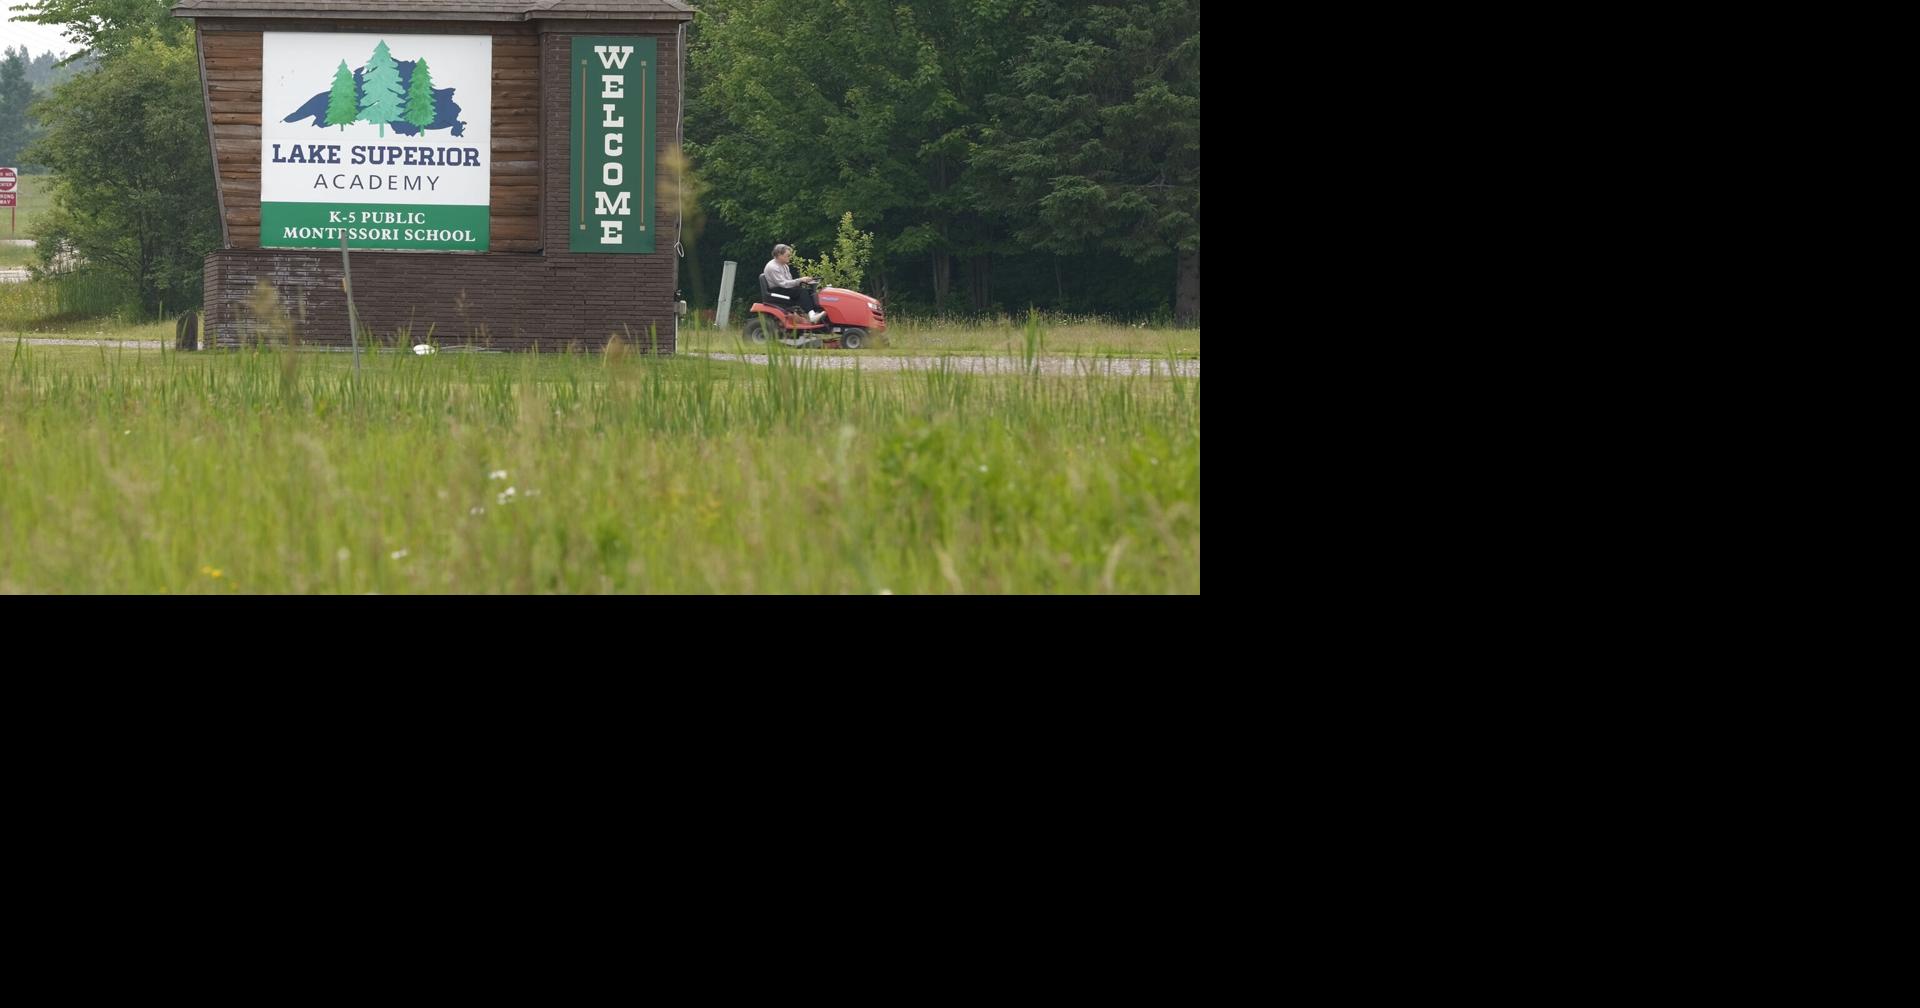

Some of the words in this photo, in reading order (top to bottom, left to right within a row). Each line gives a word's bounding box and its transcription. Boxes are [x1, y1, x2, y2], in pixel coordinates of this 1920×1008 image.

[594, 45, 634, 245] WELCOME
[272, 143, 341, 164] LAKE
[351, 145, 481, 167] SUPERIOR
[313, 173, 440, 191] ACADEMY
[329, 210, 356, 223] K-5
[361, 211, 426, 225] PUBLIC
[404, 228, 476, 242] SCHOOL
